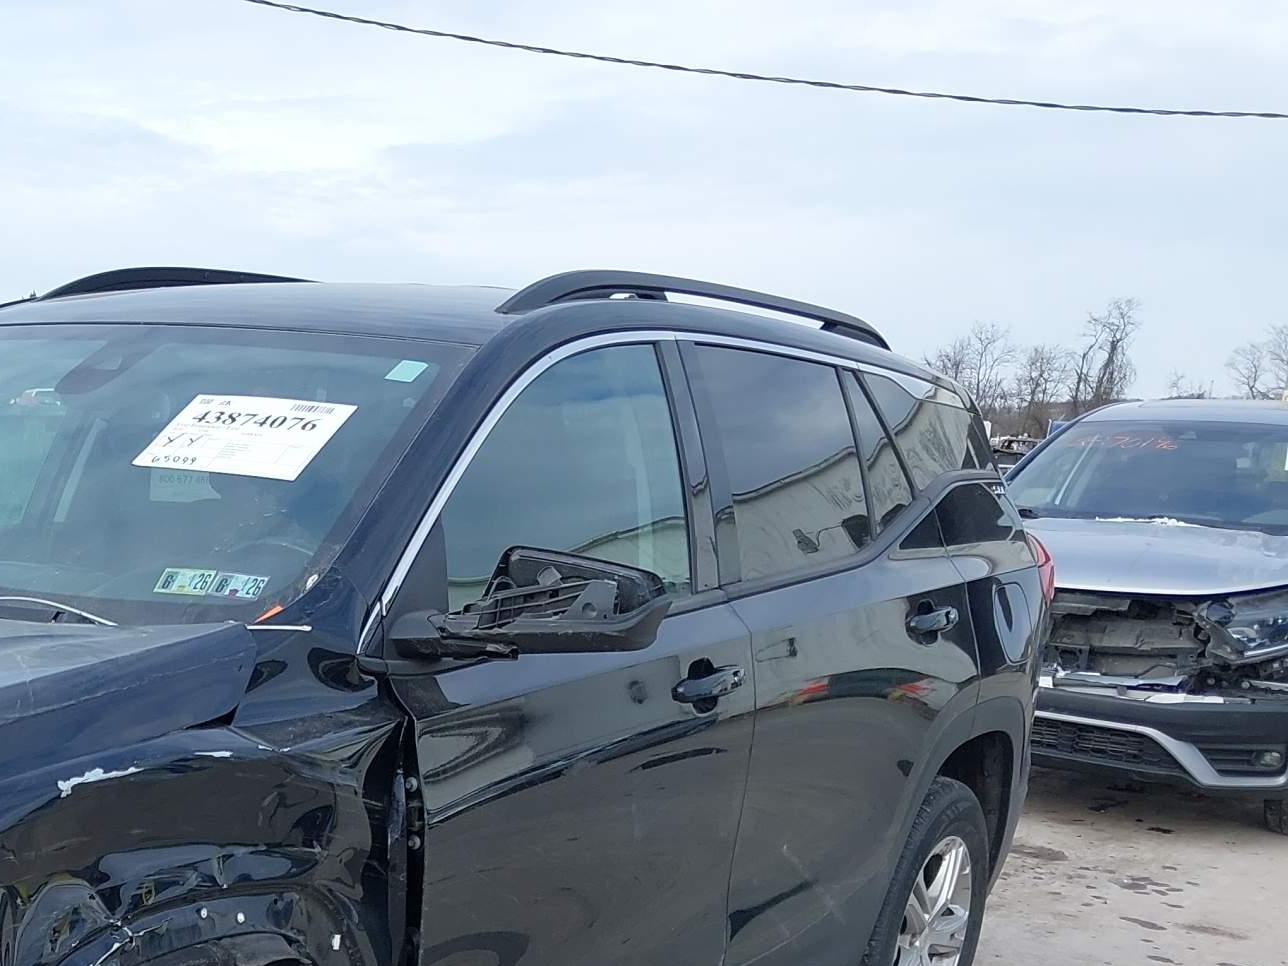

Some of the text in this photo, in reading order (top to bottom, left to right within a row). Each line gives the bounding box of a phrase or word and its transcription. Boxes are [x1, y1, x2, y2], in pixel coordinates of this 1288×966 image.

[192, 410, 320, 431] 43874076
[192, 573, 213, 591] 26
[245, 577, 266, 597] 26
